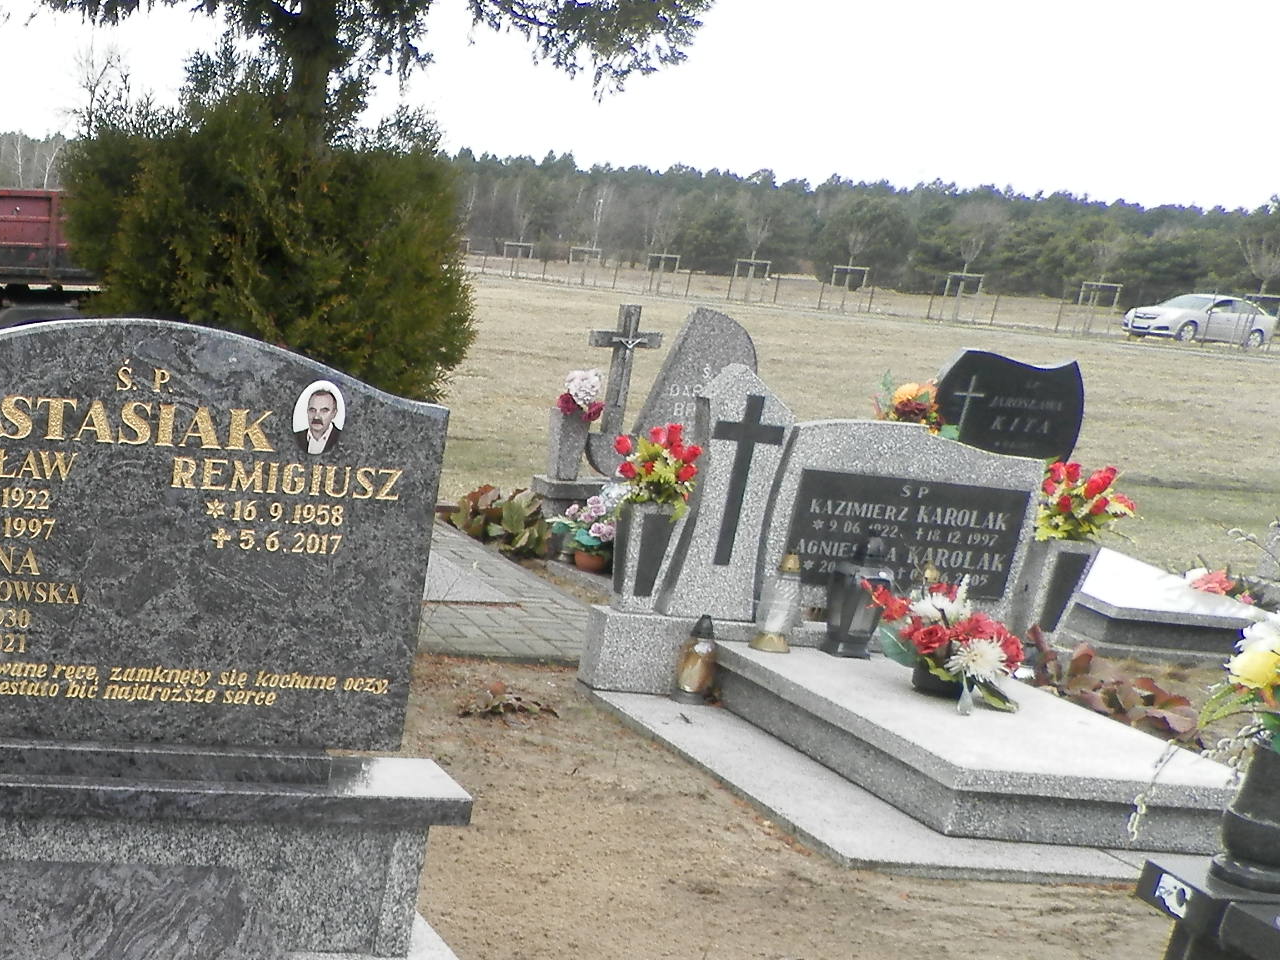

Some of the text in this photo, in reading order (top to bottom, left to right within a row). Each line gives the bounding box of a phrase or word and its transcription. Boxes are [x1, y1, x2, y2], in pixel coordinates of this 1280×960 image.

[116, 359, 173, 393] Ś. P.
[669, 383, 704, 398] DAR
[990, 416, 1049, 434] KITA
[169, 455, 405, 501] REMIGIUSZ
[809, 498, 1013, 531] KAZIMIERZ KAROLAK
[906, 545, 1007, 572] KAROLAK
[255, 670, 338, 691] kochane
[102, 682, 217, 703] najdroższe
[222, 688, 278, 706] serce
